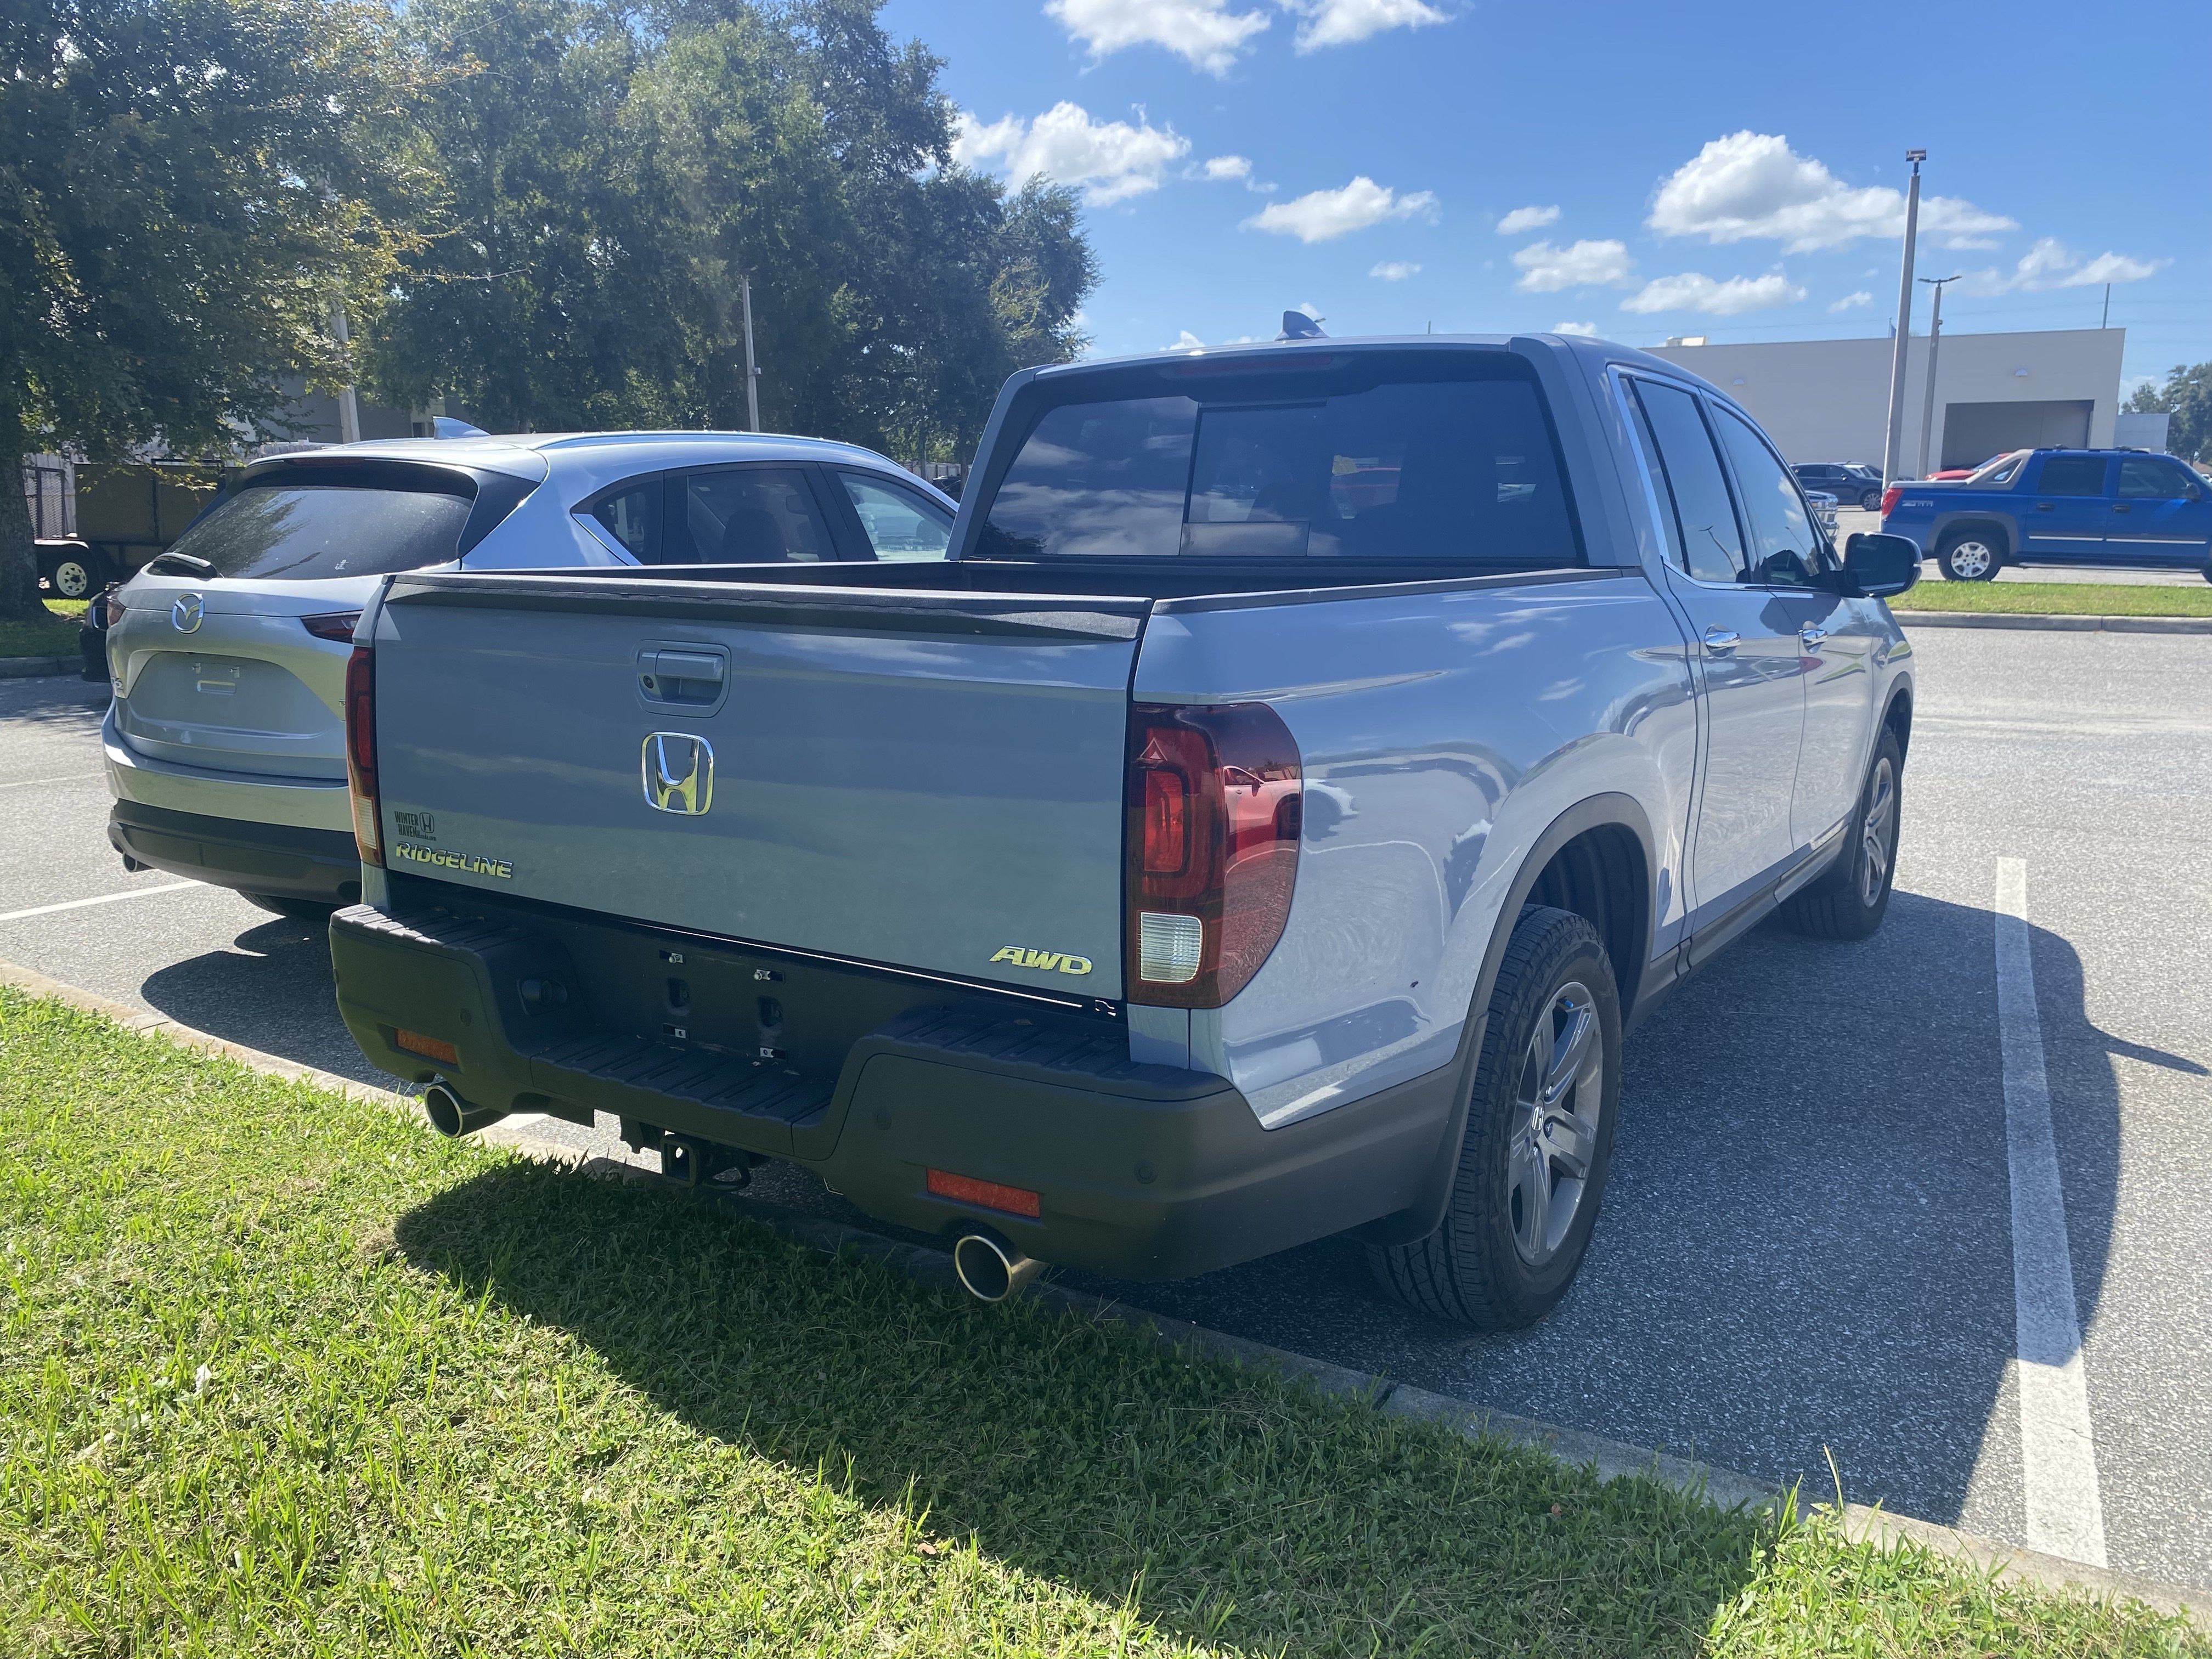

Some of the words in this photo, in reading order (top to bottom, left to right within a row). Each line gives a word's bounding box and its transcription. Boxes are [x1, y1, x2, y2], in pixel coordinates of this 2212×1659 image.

[394, 811, 419, 826] WINTER
[398, 823, 417, 838] HAVEN
[396, 842, 513, 878] RIDGELINE
[989, 945, 1092, 975] AWD
